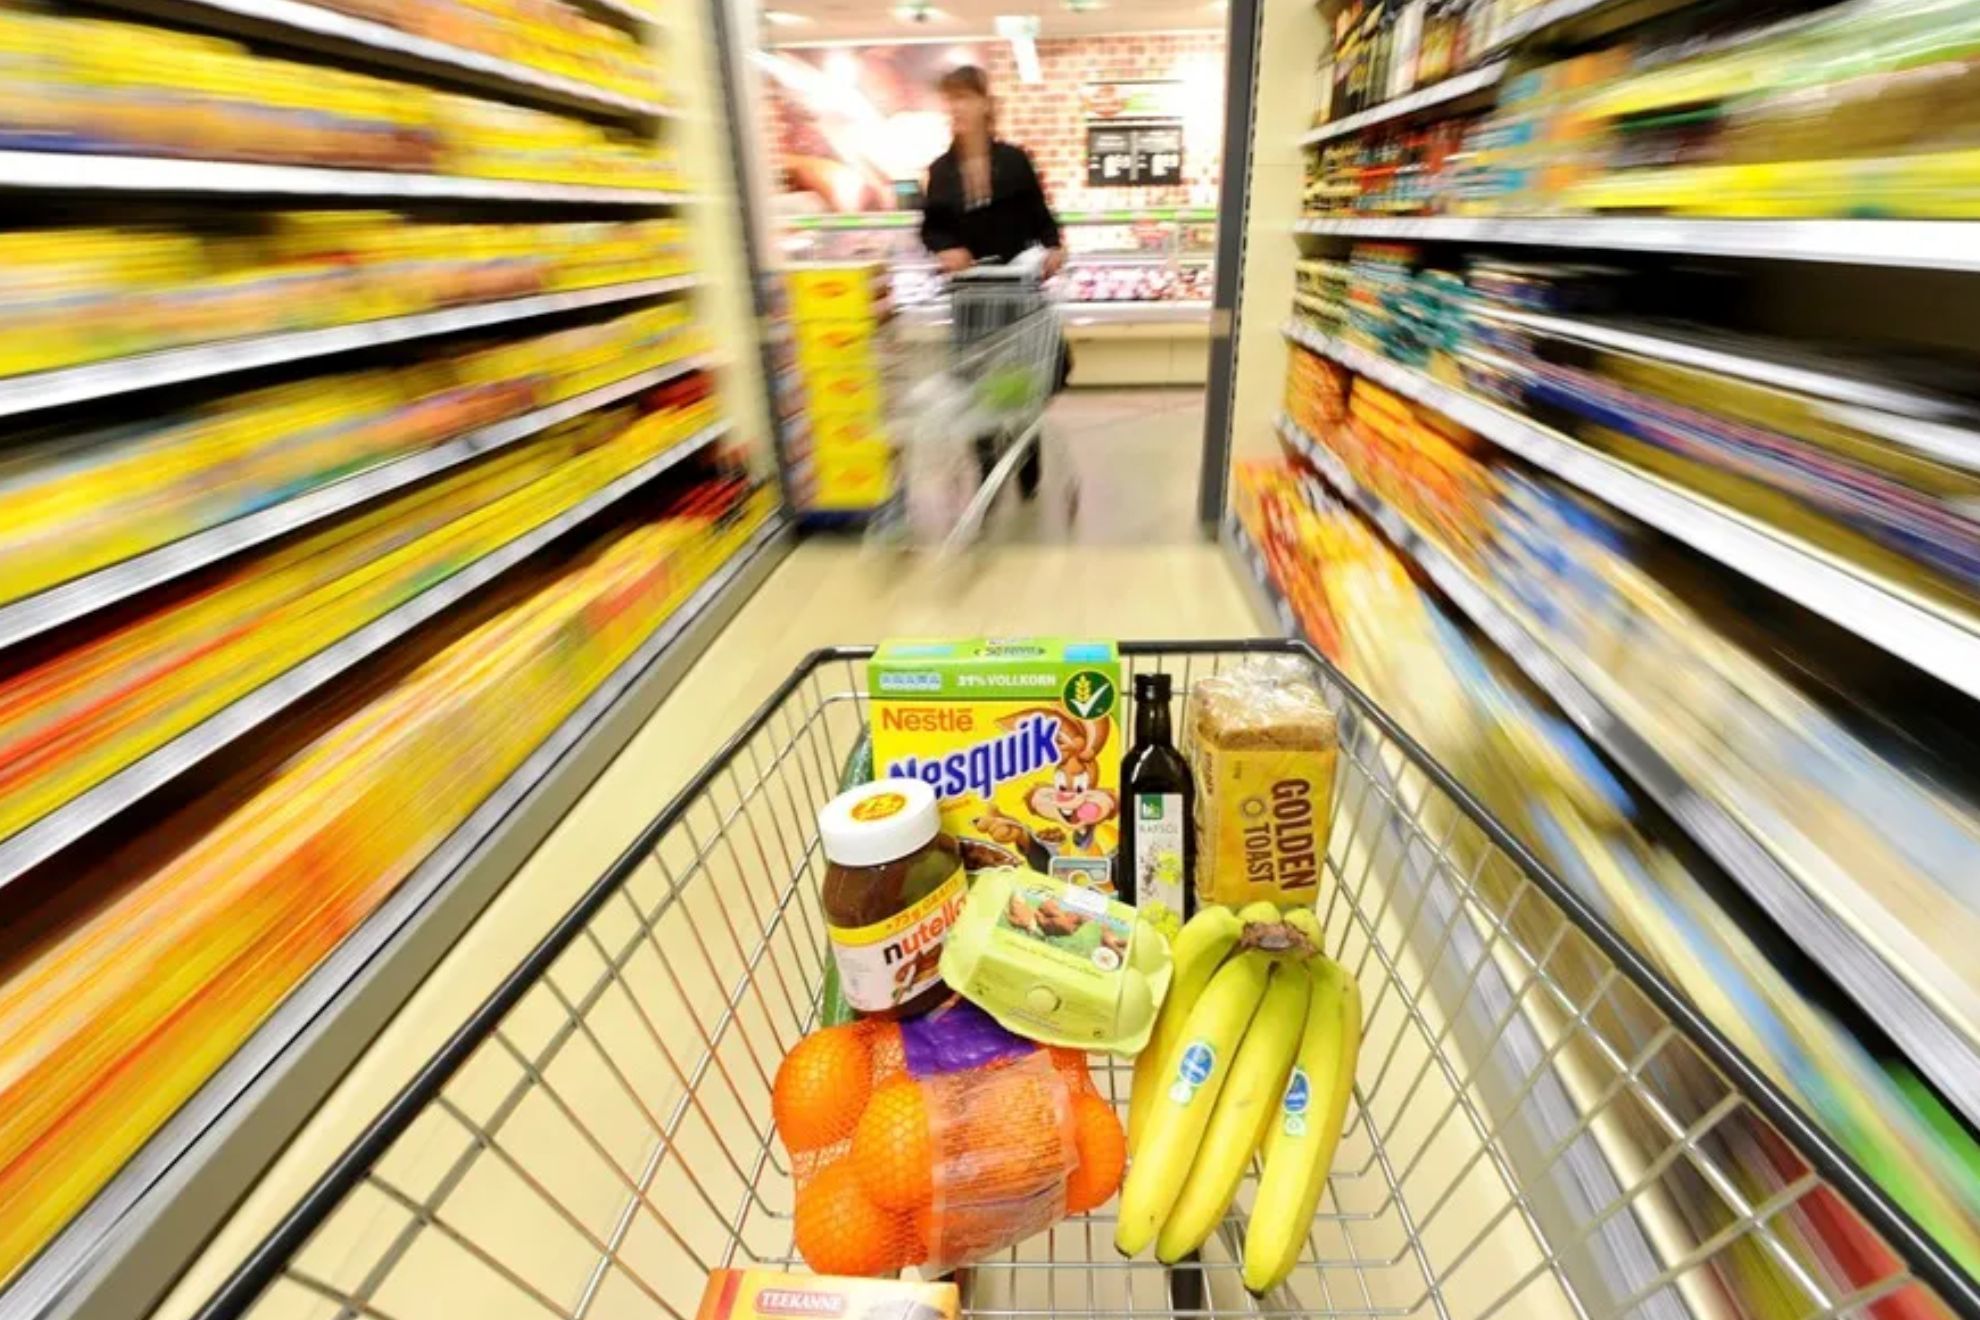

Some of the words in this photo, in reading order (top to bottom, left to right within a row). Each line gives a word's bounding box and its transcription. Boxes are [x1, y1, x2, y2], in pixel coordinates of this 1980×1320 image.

[987, 673, 1057, 687] VOLLKORN
[1243, 821, 1275, 882] TOAST
[1272, 778, 1317, 891] GOLDEN
[761, 1290, 842, 1313] TEEKANNE
